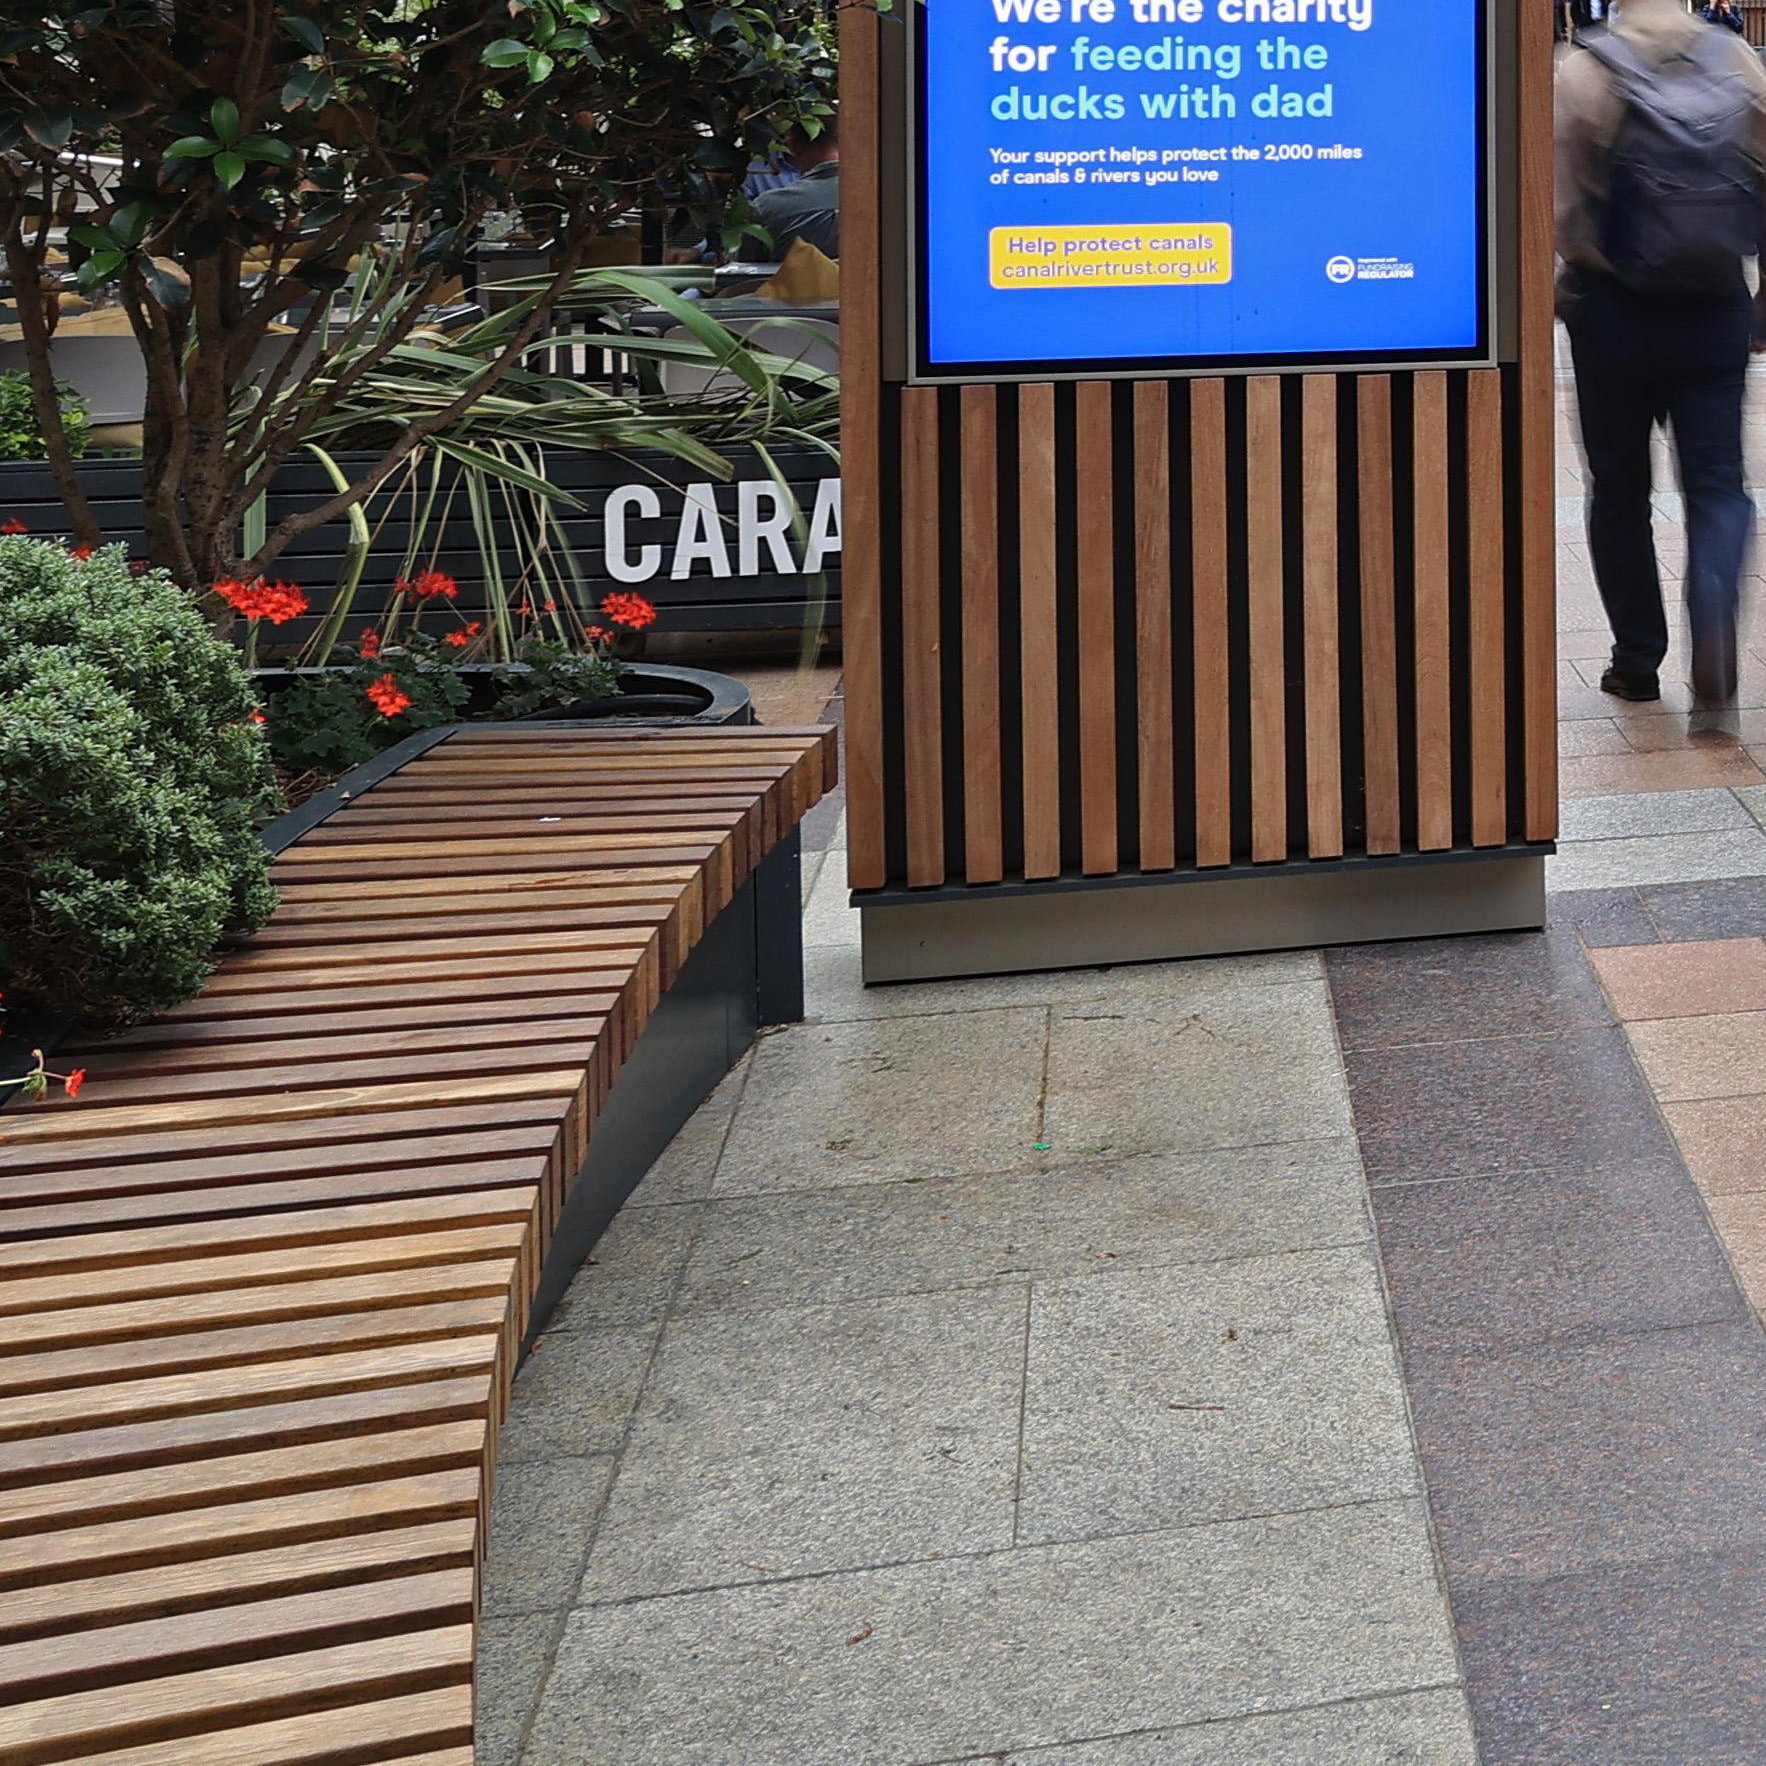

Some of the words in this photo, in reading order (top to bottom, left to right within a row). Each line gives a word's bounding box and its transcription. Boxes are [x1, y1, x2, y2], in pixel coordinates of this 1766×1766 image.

[989, 36, 1057, 71] for
[1071, 36, 1241, 79] feeding
[1256, 37, 1328, 69] the
[991, 86, 1125, 120] ducks
[1140, 84, 1236, 118] with
[1252, 84, 1332, 118] dad
[990, 148, 1030, 163] Your
[1035, 149, 1106, 166] support
[1110, 146, 1157, 165] helps
[1162, 148, 1227, 165] protect
[1231, 145, 1260, 160] the
[1265, 144, 1313, 161] 2,000
[1317, 144, 1362, 159] miles
[990, 169, 1010, 184] of
[1014, 168, 1070, 184] canals
[1074, 168, 1086, 183] &
[1091, 168, 1140, 183] rivers
[1145, 171, 1178, 186] you
[1182, 167, 1219, 181] love
[1007, 237, 1058, 256] Help
[1062, 237, 1142, 256] protect
[1147, 234, 1215, 251] canals
[1000, 258, 1219, 279] canalrivertrust.org.uk
[1331, 264, 1351, 276] FR
[1357, 271, 1414, 280] REGULATOR
